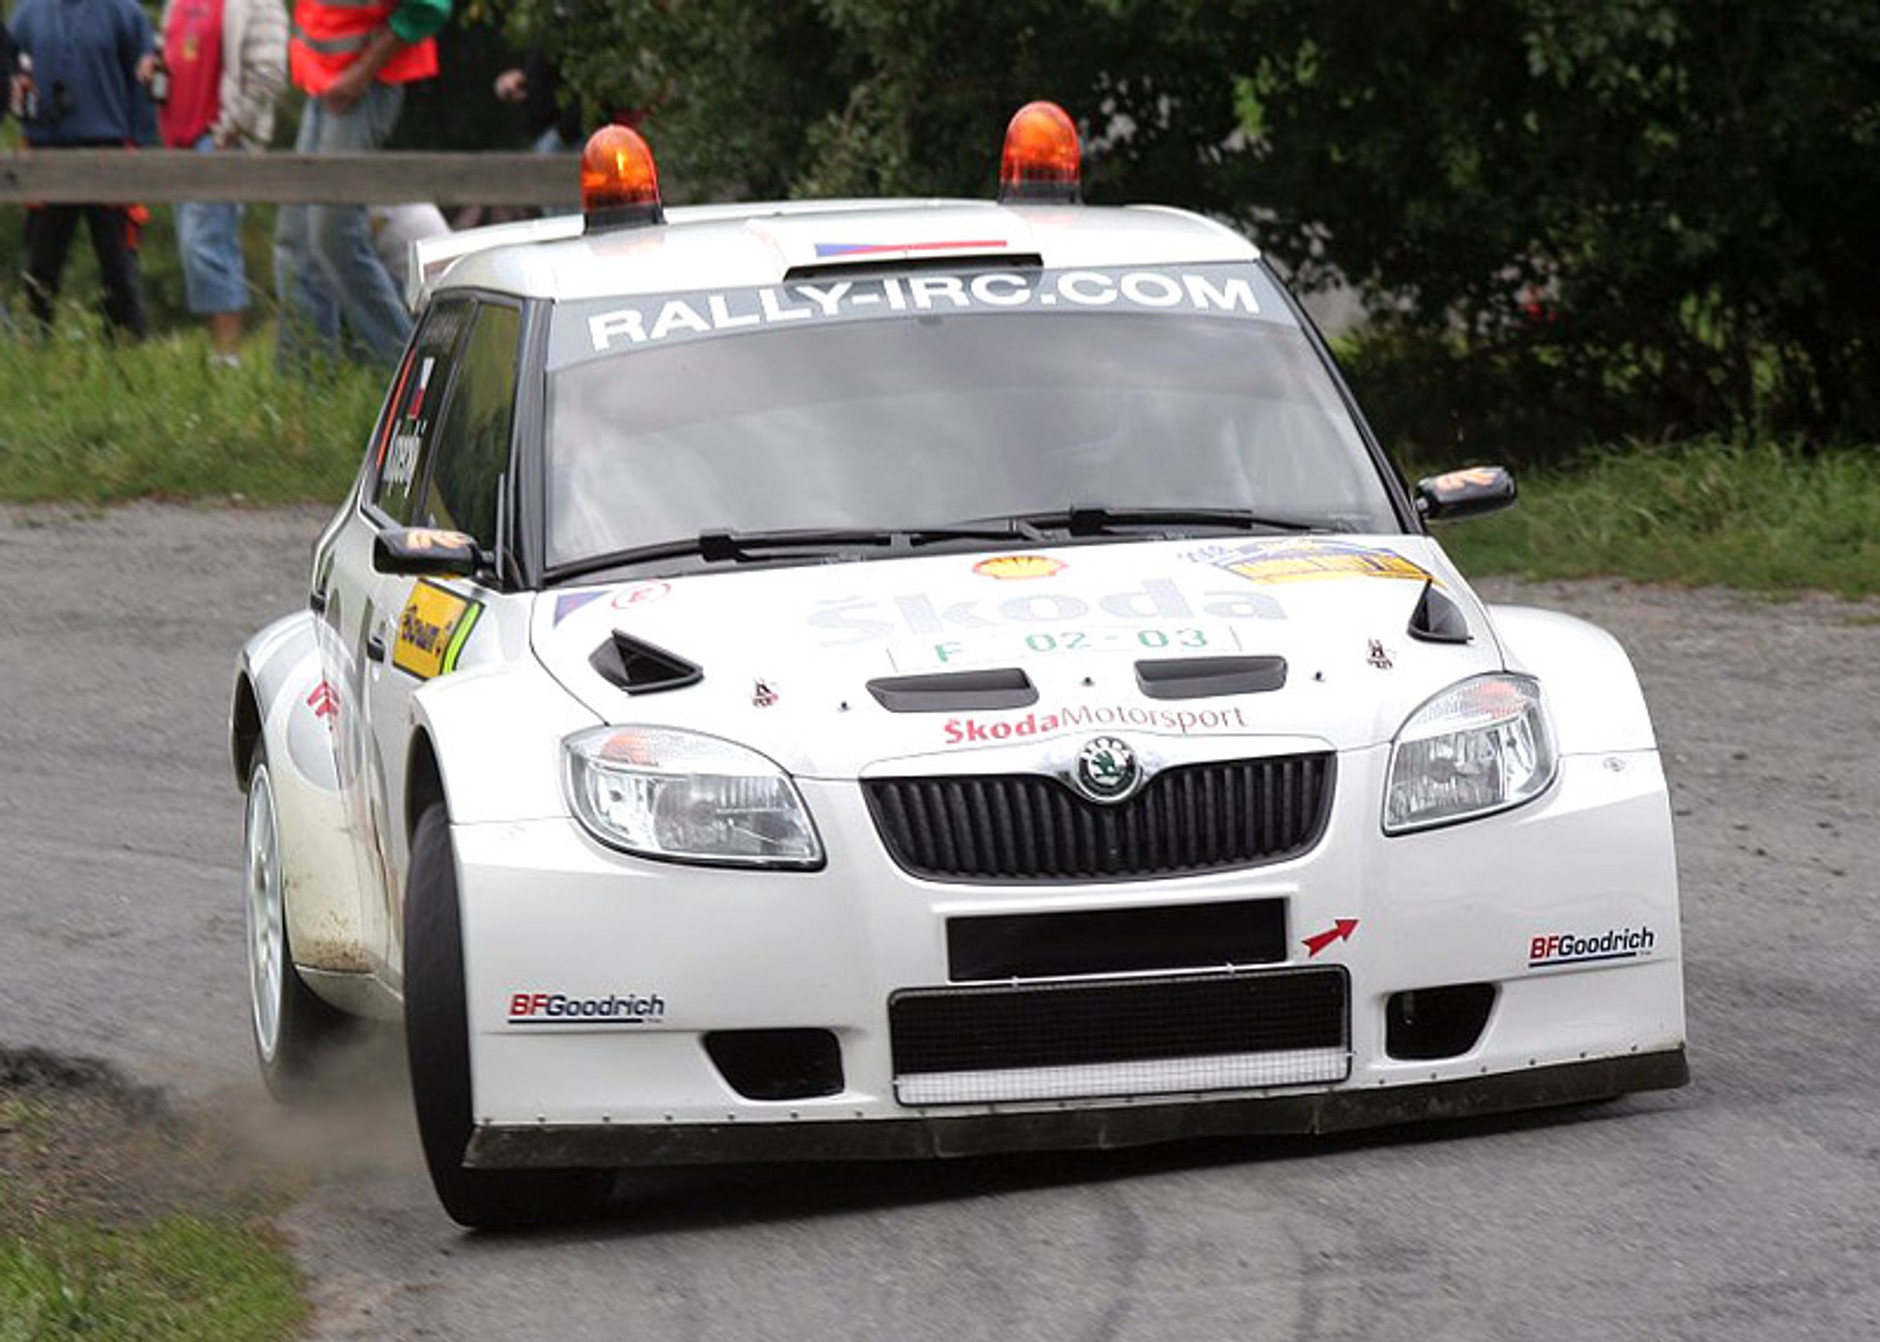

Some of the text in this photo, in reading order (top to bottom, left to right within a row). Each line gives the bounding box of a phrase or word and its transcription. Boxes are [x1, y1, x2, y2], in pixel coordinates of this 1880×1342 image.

[587, 270, 1261, 352] RALLY-IRC.COM
[1530, 926, 1655, 960] BFGoodrich
[510, 994, 665, 1017] BFGoodrich
